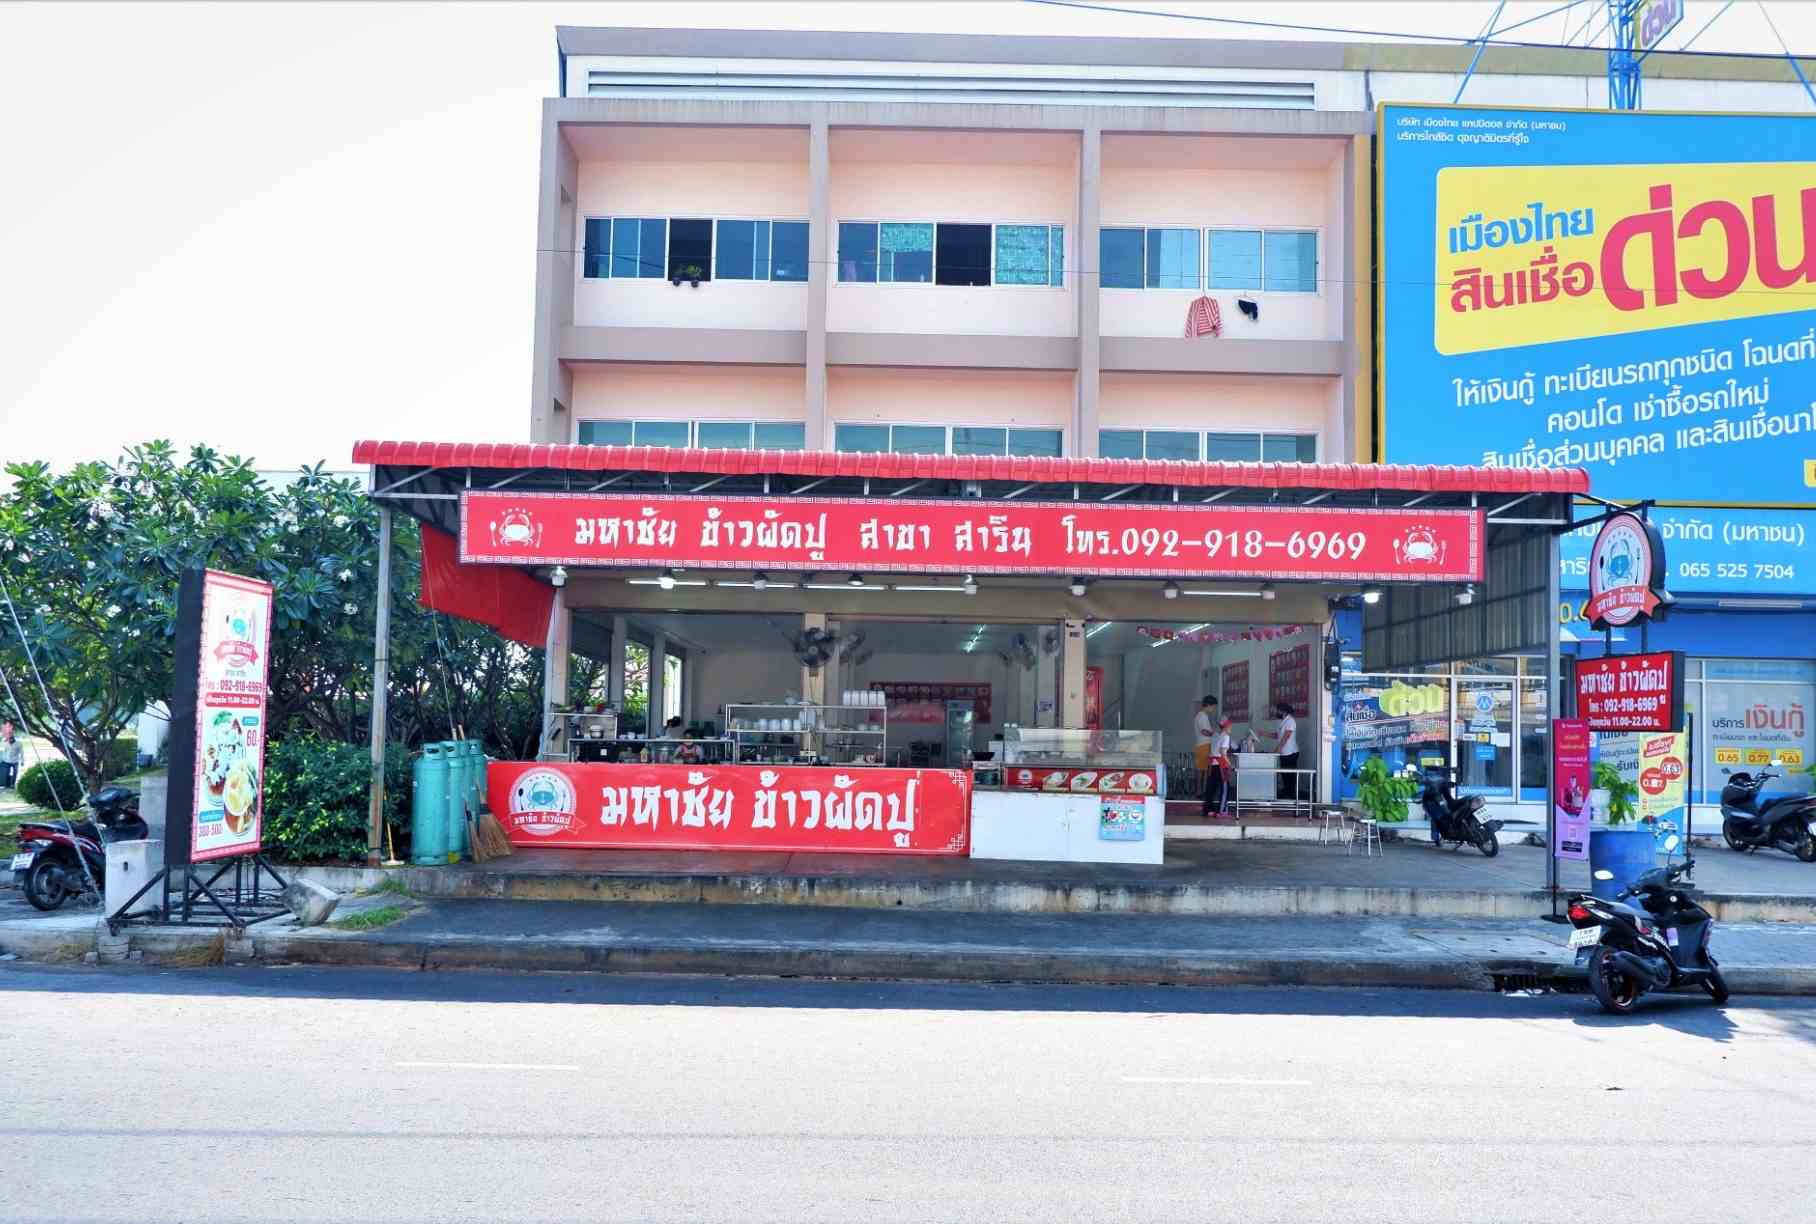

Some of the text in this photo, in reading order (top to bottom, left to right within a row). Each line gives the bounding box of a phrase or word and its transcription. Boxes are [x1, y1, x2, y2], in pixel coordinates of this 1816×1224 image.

[1448, 201, 1595, 254] เมืองไทย
[1599, 183, 1816, 312] ด่วน
[1450, 246, 1595, 312] สินเชื่อ
[1452, 372, 1537, 408] ให้เงินกู้
[1544, 348, 1734, 397] ทะเบียนรถทุกชนิด
[1547, 377, 1770, 434] คอนโด เช่าซื้อรถใหม่
[575, 507, 677, 548] มหาชัย
[701, 508, 828, 560] ข้าวผัดปู
[859, 517, 932, 552] สาขา
[1663, 518, 1806, 547] จำกัด (มหาชน)
[1680, 562, 1711, 577] 065
[1716, 563, 1748, 578] 525
[1754, 564, 1794, 579] 7504
[1745, 703, 1805, 738] เงินกู้
[601, 769, 918, 848] มหาชัย ข้าวผัดปู
